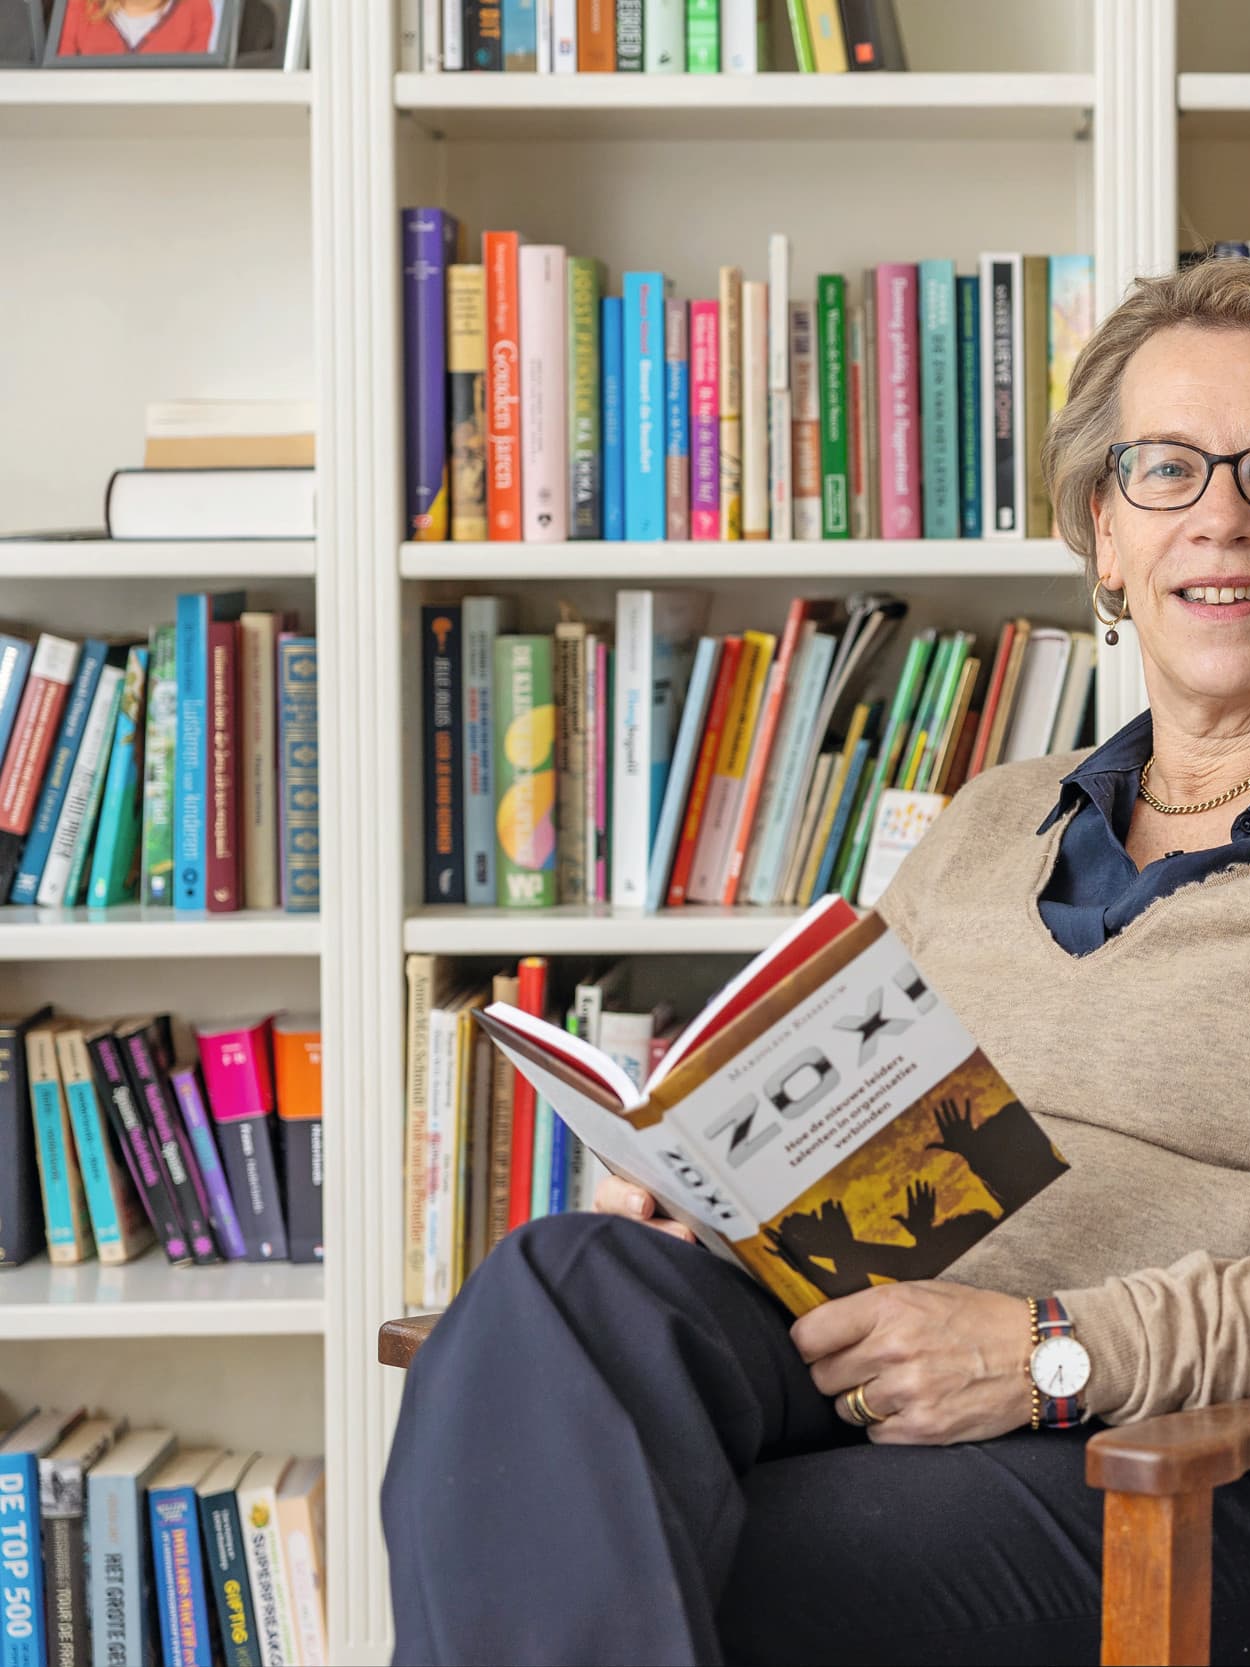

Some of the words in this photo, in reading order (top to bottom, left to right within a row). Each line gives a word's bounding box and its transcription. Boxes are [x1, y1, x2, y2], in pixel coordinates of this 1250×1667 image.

[492, 339, 519, 429] Gouden
[490, 434, 515, 489] jaren
[784, 1131, 809, 1152] Hoe
[809, 1119, 825, 1134] de
[824, 1086, 865, 1121] nieuwe
[863, 1054, 904, 1088] leiders
[789, 1127, 838, 1168] talenten
[849, 1062, 918, 1119] organisaties
[834, 1101, 892, 1149] verbinden
[0, 1472, 25, 1515] DE
[2, 1520, 29, 1579] TOP
[4, 1586, 33, 1639] 500
